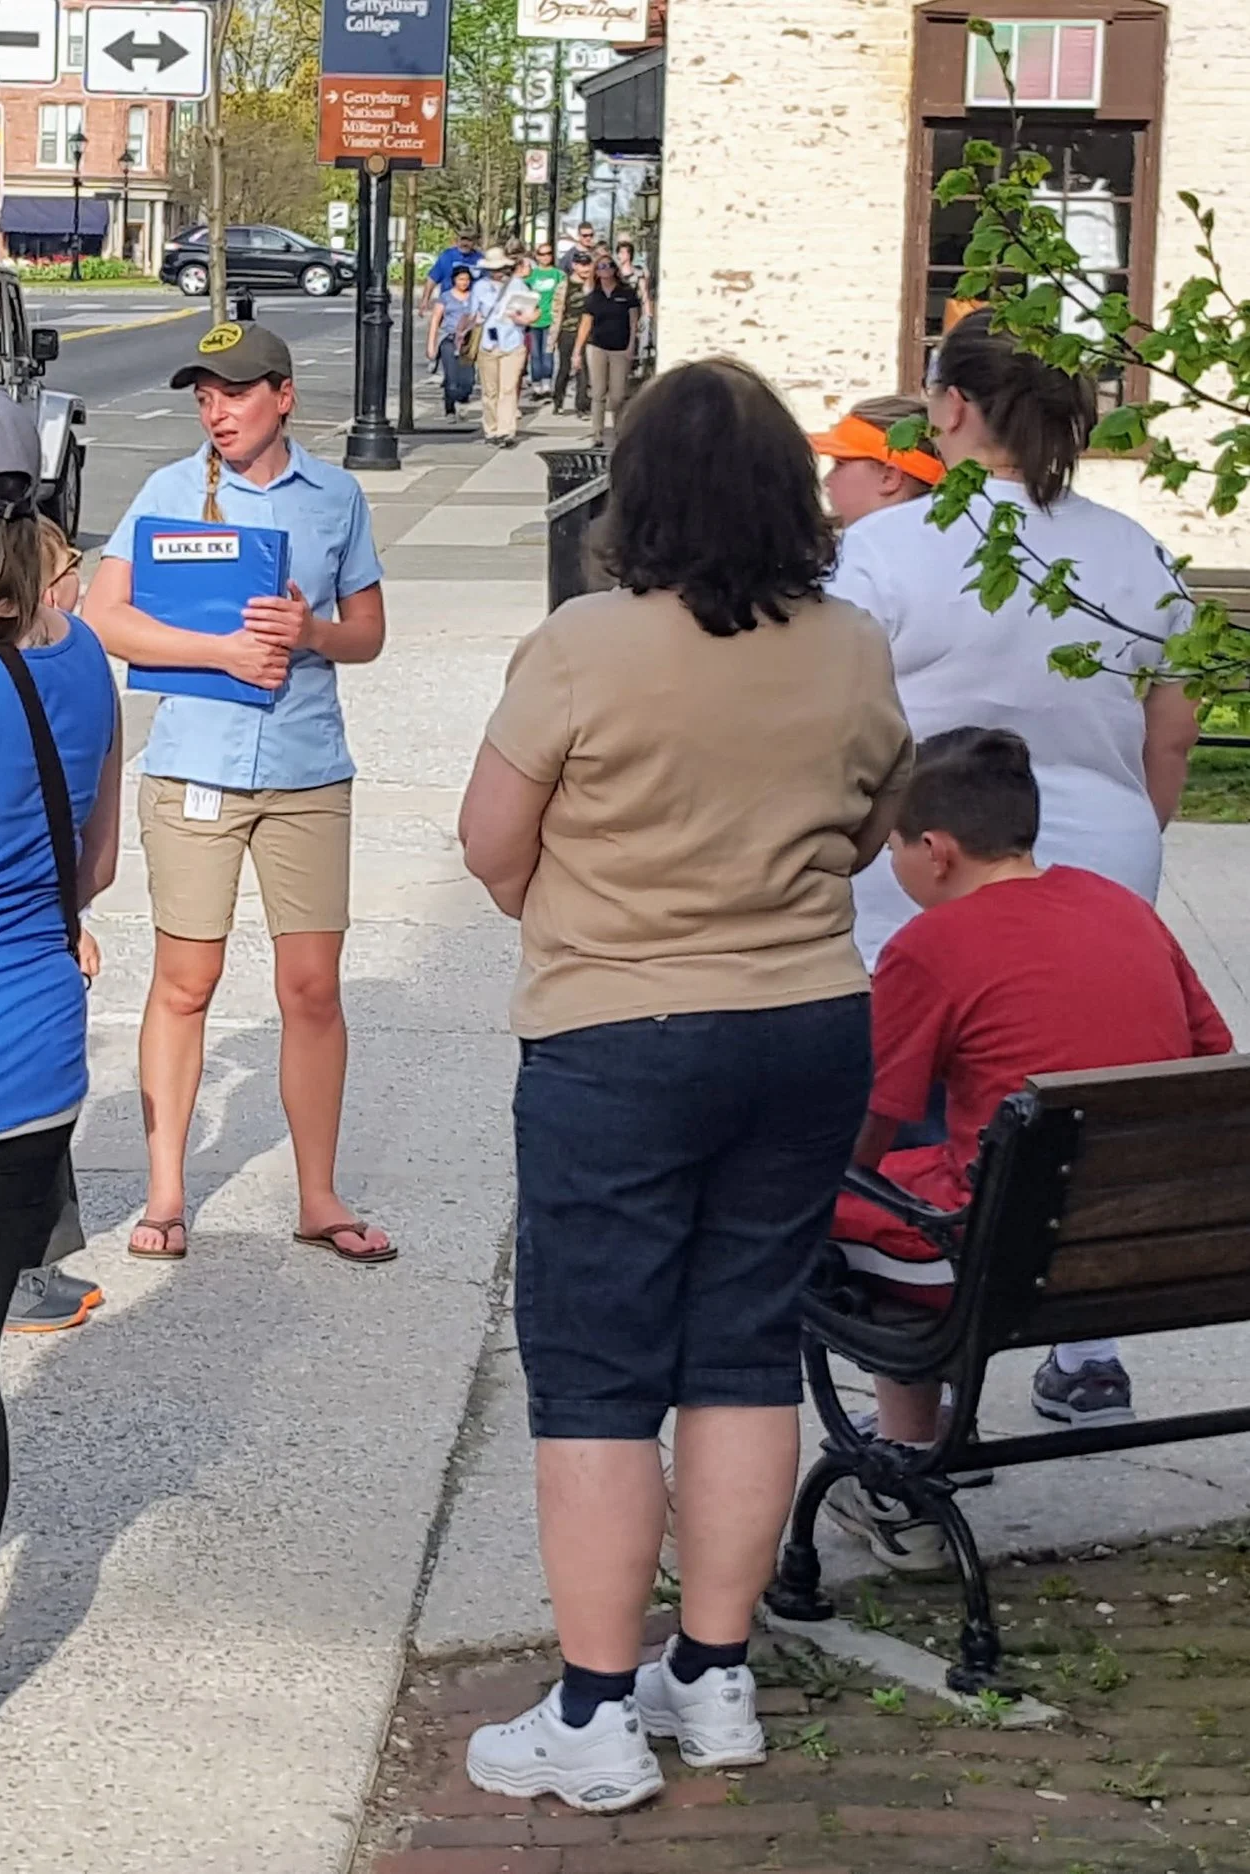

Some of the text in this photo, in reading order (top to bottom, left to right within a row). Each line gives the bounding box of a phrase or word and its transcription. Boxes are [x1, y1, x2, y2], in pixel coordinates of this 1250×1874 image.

[345, 15, 400, 37] College
[342, 90, 411, 108] Gettysburg
[342, 106, 395, 119] National
[342, 120, 419, 137] Military Park
[342, 135, 426, 149] Visitor Center
[168, 542, 203, 554] LIKE
